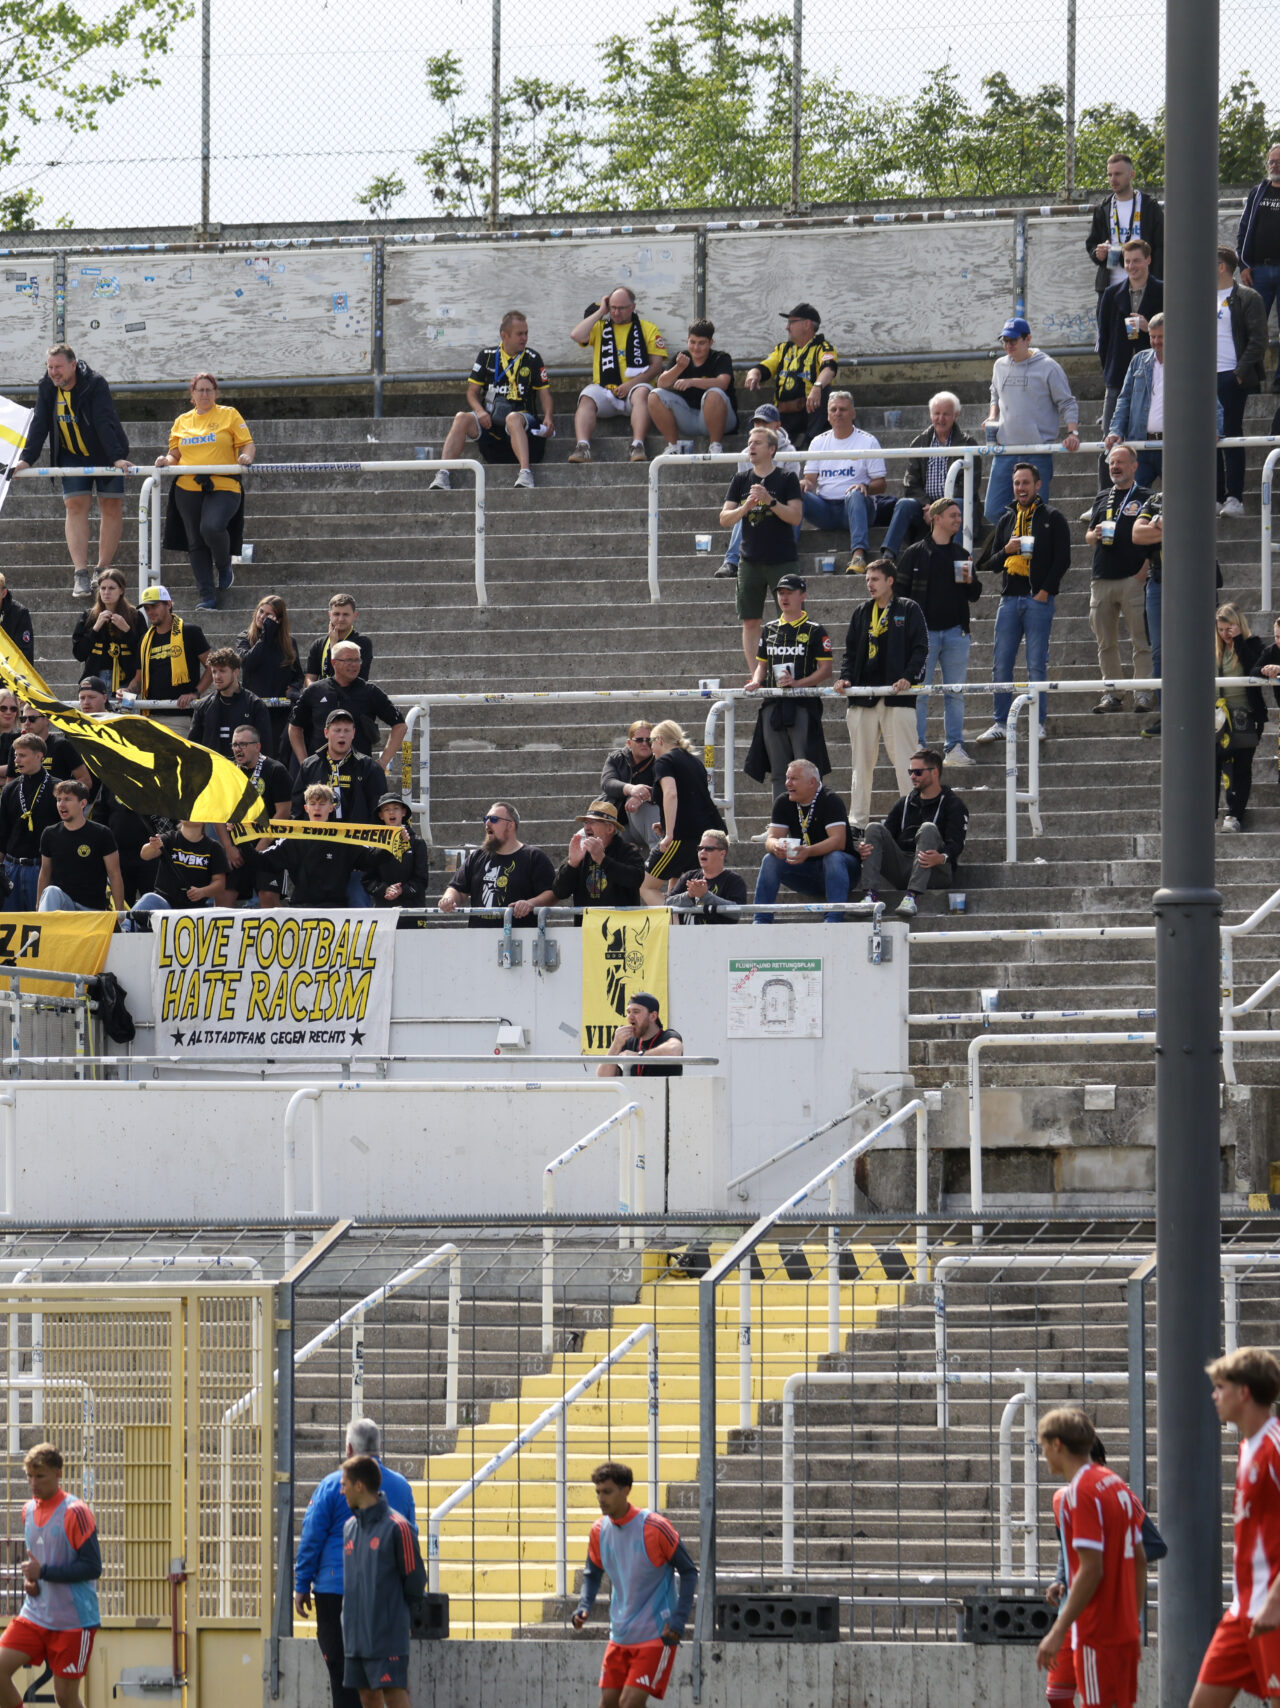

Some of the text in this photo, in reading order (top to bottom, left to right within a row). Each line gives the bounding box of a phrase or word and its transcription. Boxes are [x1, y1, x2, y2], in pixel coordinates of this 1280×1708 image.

[181, 432, 216, 446] maxit
[767, 645, 805, 656] maxit
[178, 852, 203, 866] WSK
[158, 915, 378, 971] LOVE FOOTBALL
[161, 970, 373, 1022] HATE RACISM
[187, 1030, 346, 1047] ALTSTADTFANS GEGEN RECHTS
